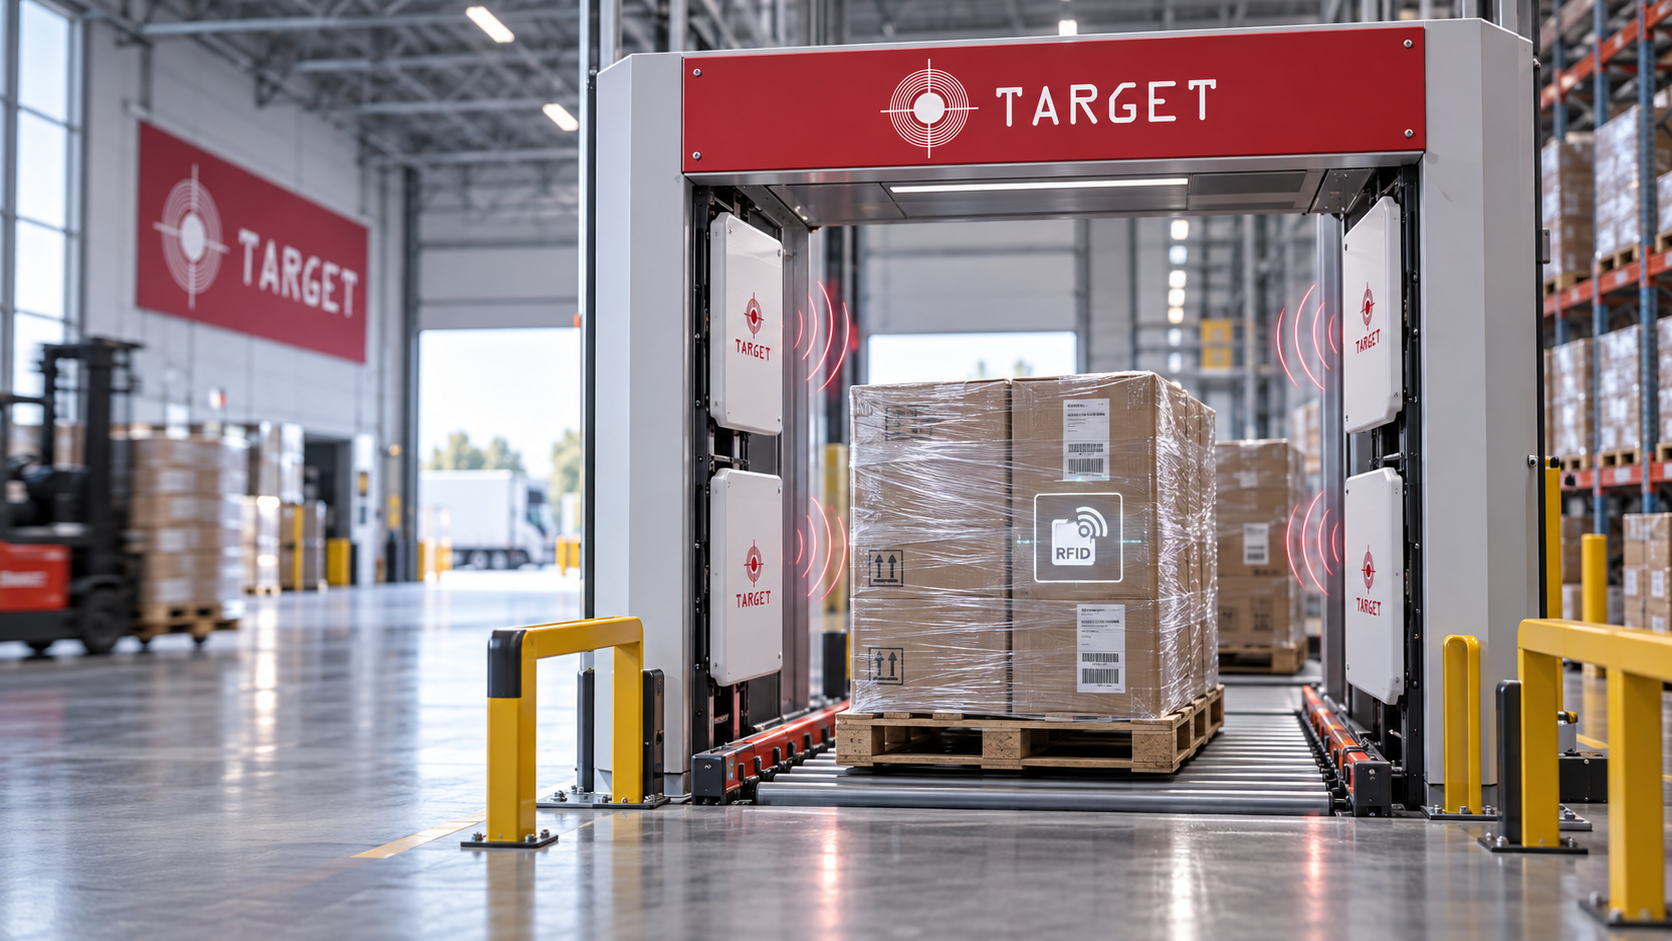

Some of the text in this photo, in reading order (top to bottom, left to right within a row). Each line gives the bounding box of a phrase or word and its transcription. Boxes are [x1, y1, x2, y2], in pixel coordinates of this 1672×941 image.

[996, 80, 1217, 127] TARGET
[239, 229, 359, 317] TARGET
[735, 338, 771, 361] TARGET
[1355, 329, 1381, 354] TARGET
[736, 590, 771, 608] TARGET
[1356, 597, 1382, 617] TARGET
